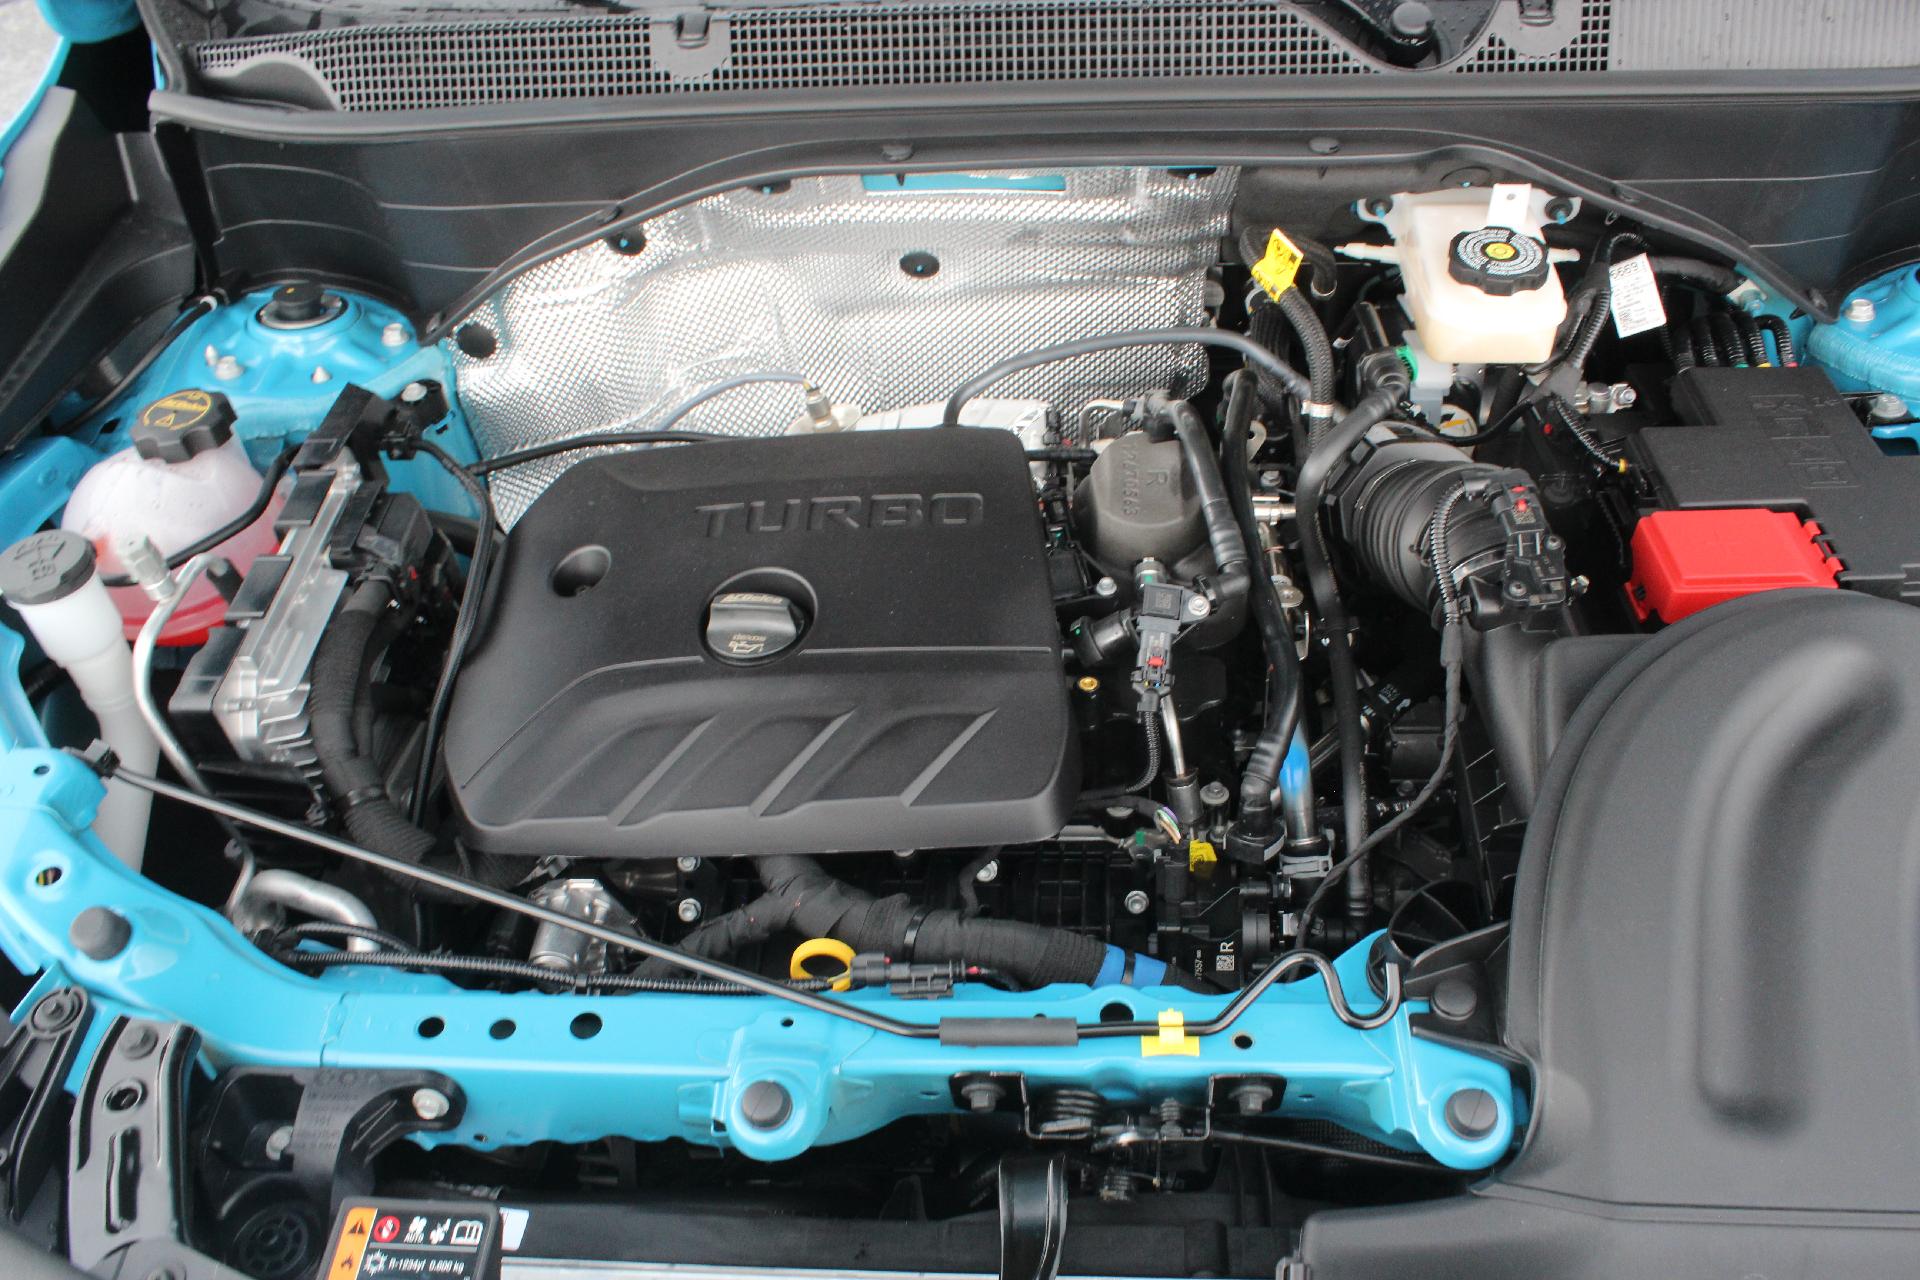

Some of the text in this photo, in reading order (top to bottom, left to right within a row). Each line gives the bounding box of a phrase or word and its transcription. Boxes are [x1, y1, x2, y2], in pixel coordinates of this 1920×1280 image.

[695, 492, 984, 538] TURBO
[1220, 941, 1234, 952] R
[403, 1232, 425, 1244] AUTO
